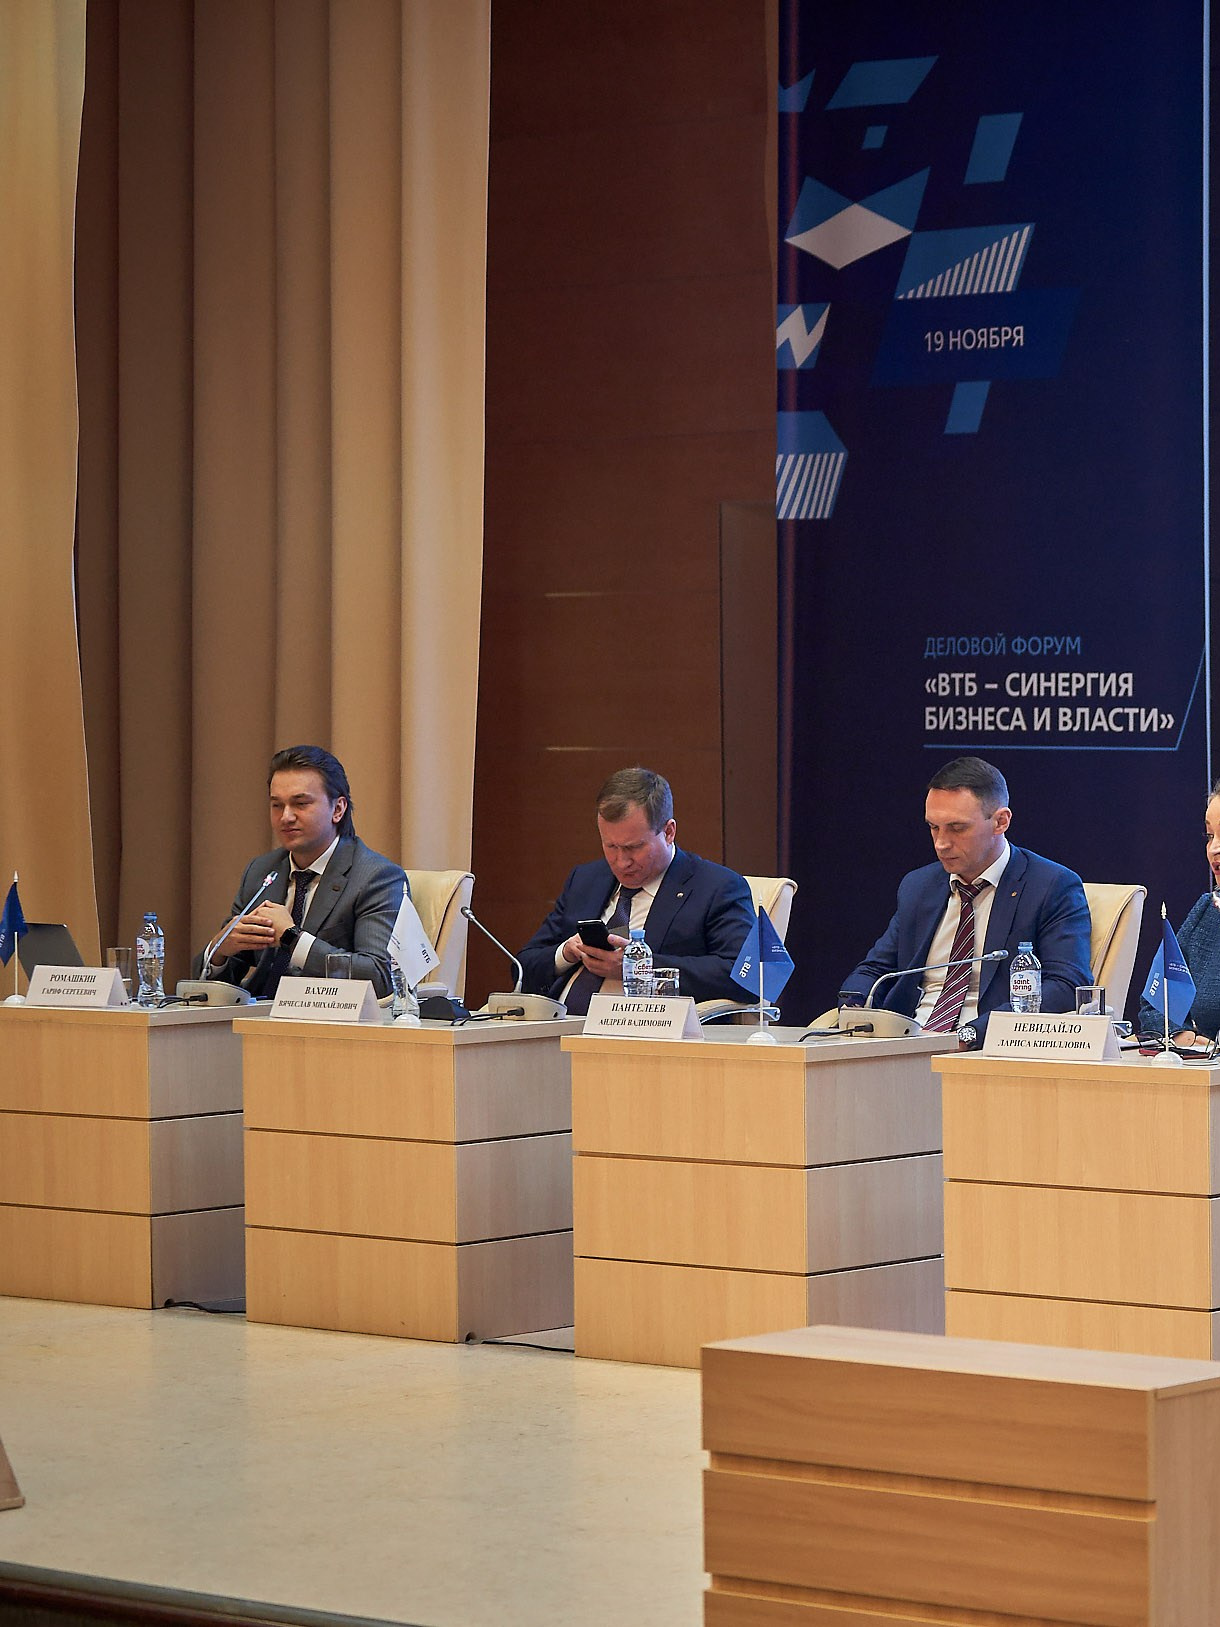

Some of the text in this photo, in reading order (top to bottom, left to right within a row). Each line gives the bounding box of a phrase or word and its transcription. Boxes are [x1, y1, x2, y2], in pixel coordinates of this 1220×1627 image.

[924, 326, 1024, 352] 19 НОЯБРЯ
[924, 633, 1081, 659] ДЕЛОВОЙ ФОРУМ
[924, 672, 977, 697] «ВТБ
[1005, 672, 1133, 697] СИНЕРГИЯ
[924, 706, 1175, 732] БИЗНЕСА И ВЛАСТИ»
[49, 974, 97, 983] РОМАШКИН
[62, 988, 97, 996] СЕРГЕЕВИЧ
[304, 986, 339, 996] ВАХРИН
[278, 1000, 358, 1010] ВЯЧЕСЛАВ МИХАЙЛОВИЧ
[611, 1003, 666, 1013] ПАНТЕЛЕЕВ
[599, 1018, 672, 1027] АНДРЕЙ ВАДИМОВИЧ
[1013, 1022, 1082, 1034] НЕВИДАЙЛО
[997, 1039, 1091, 1049] ЛАРИСА КИРИЛЛОВНА
